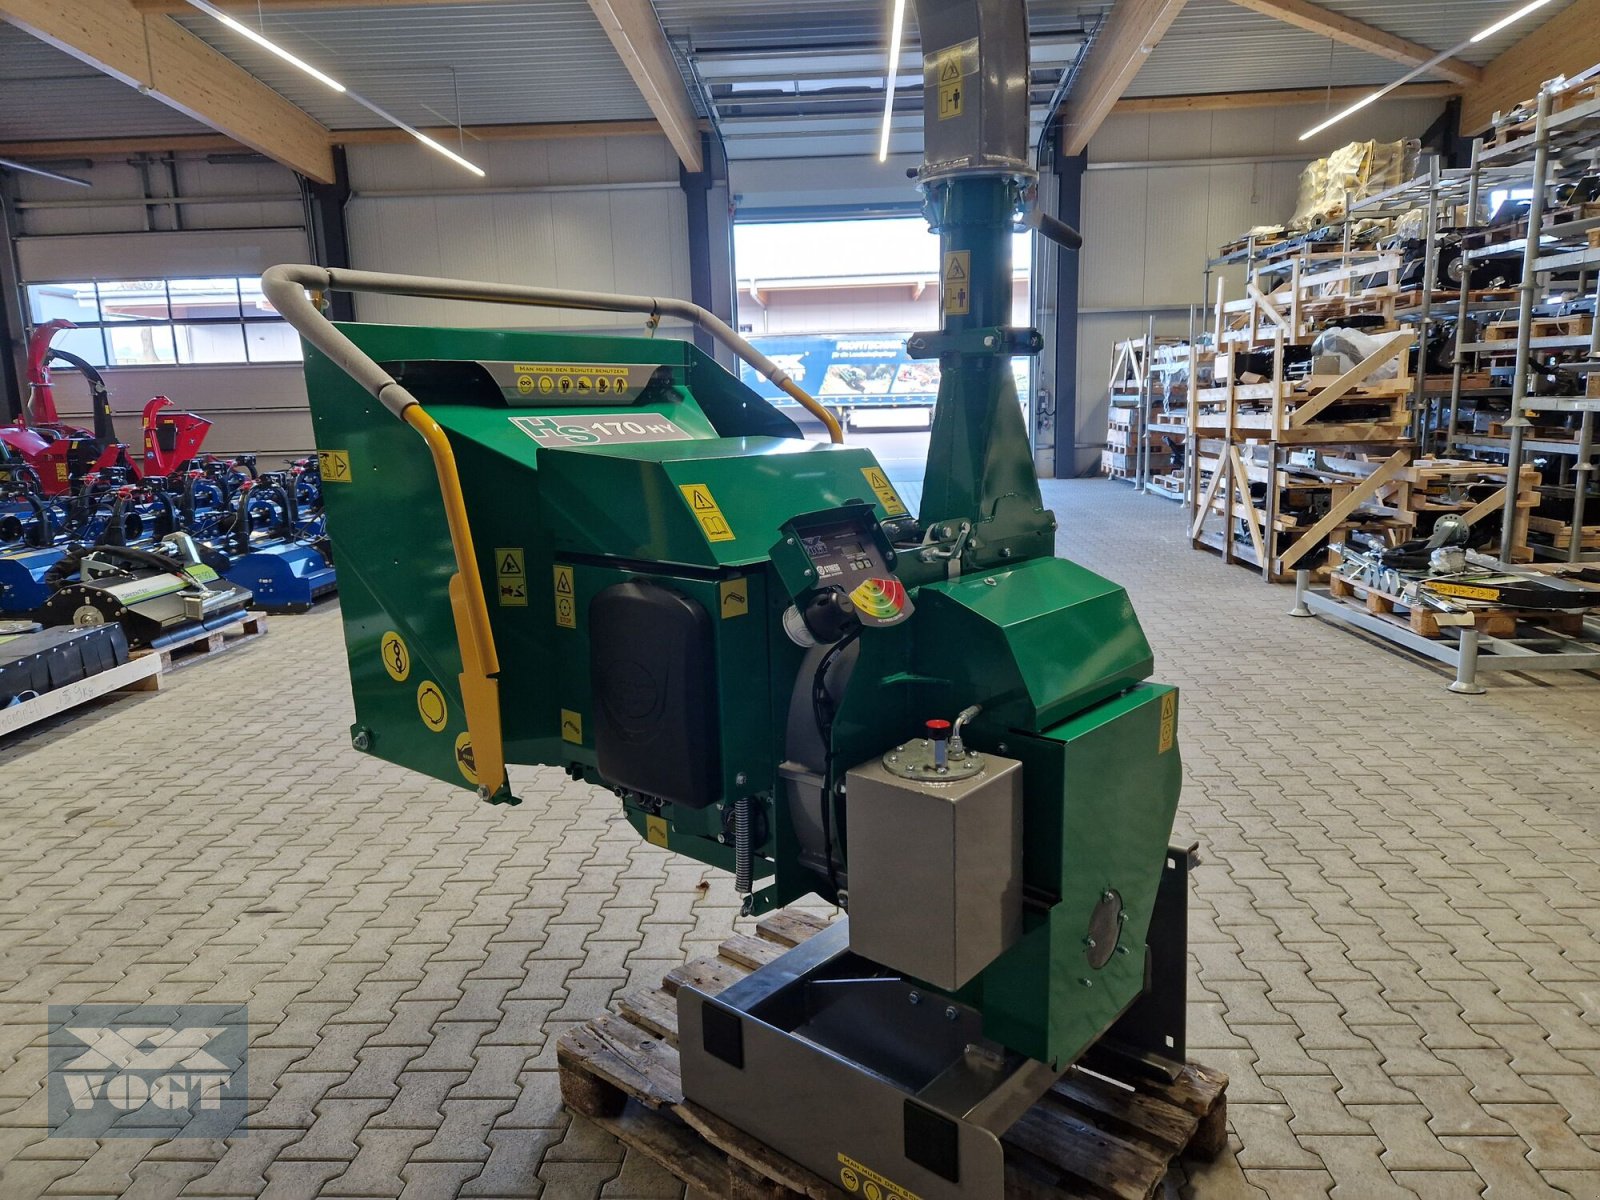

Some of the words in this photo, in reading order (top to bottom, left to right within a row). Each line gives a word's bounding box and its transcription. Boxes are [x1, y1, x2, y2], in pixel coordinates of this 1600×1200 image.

[512, 416, 601, 445] HS
[591, 421, 646, 436] 170
[645, 424, 675, 434] HY
